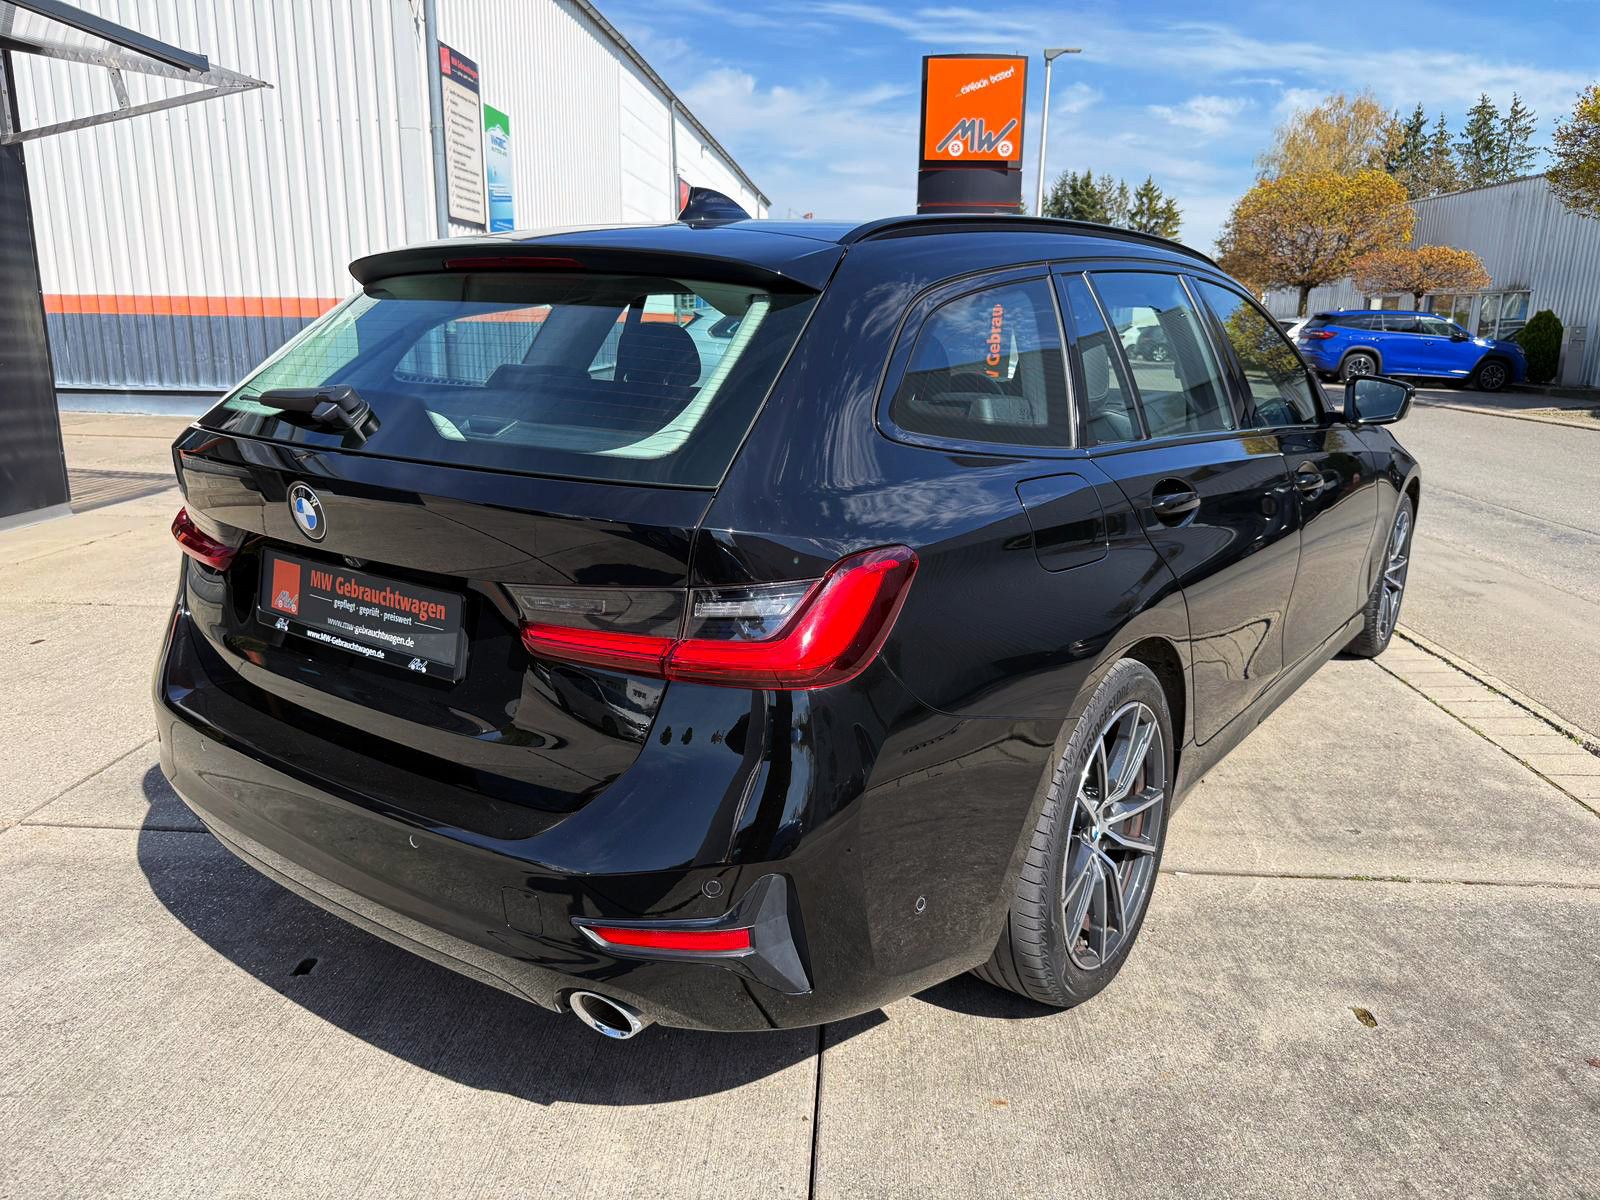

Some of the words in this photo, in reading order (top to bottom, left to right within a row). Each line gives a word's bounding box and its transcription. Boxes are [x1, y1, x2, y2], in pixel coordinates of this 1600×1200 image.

[936, 117, 1018, 153] MW
[986, 303, 1003, 367] Gebrau
[310, 569, 333, 592] MW
[335, 578, 446, 622] Gebrauchtwagen
[333, 599, 356, 613] gepflegt
[358, 604, 381, 619] geprüft
[383, 611, 412, 626] preiswert
[306, 629, 385, 659] www.MW-Gebrauchtwagen.de
[327, 616, 415, 648] www.mw-gebrauchtwagen.de
